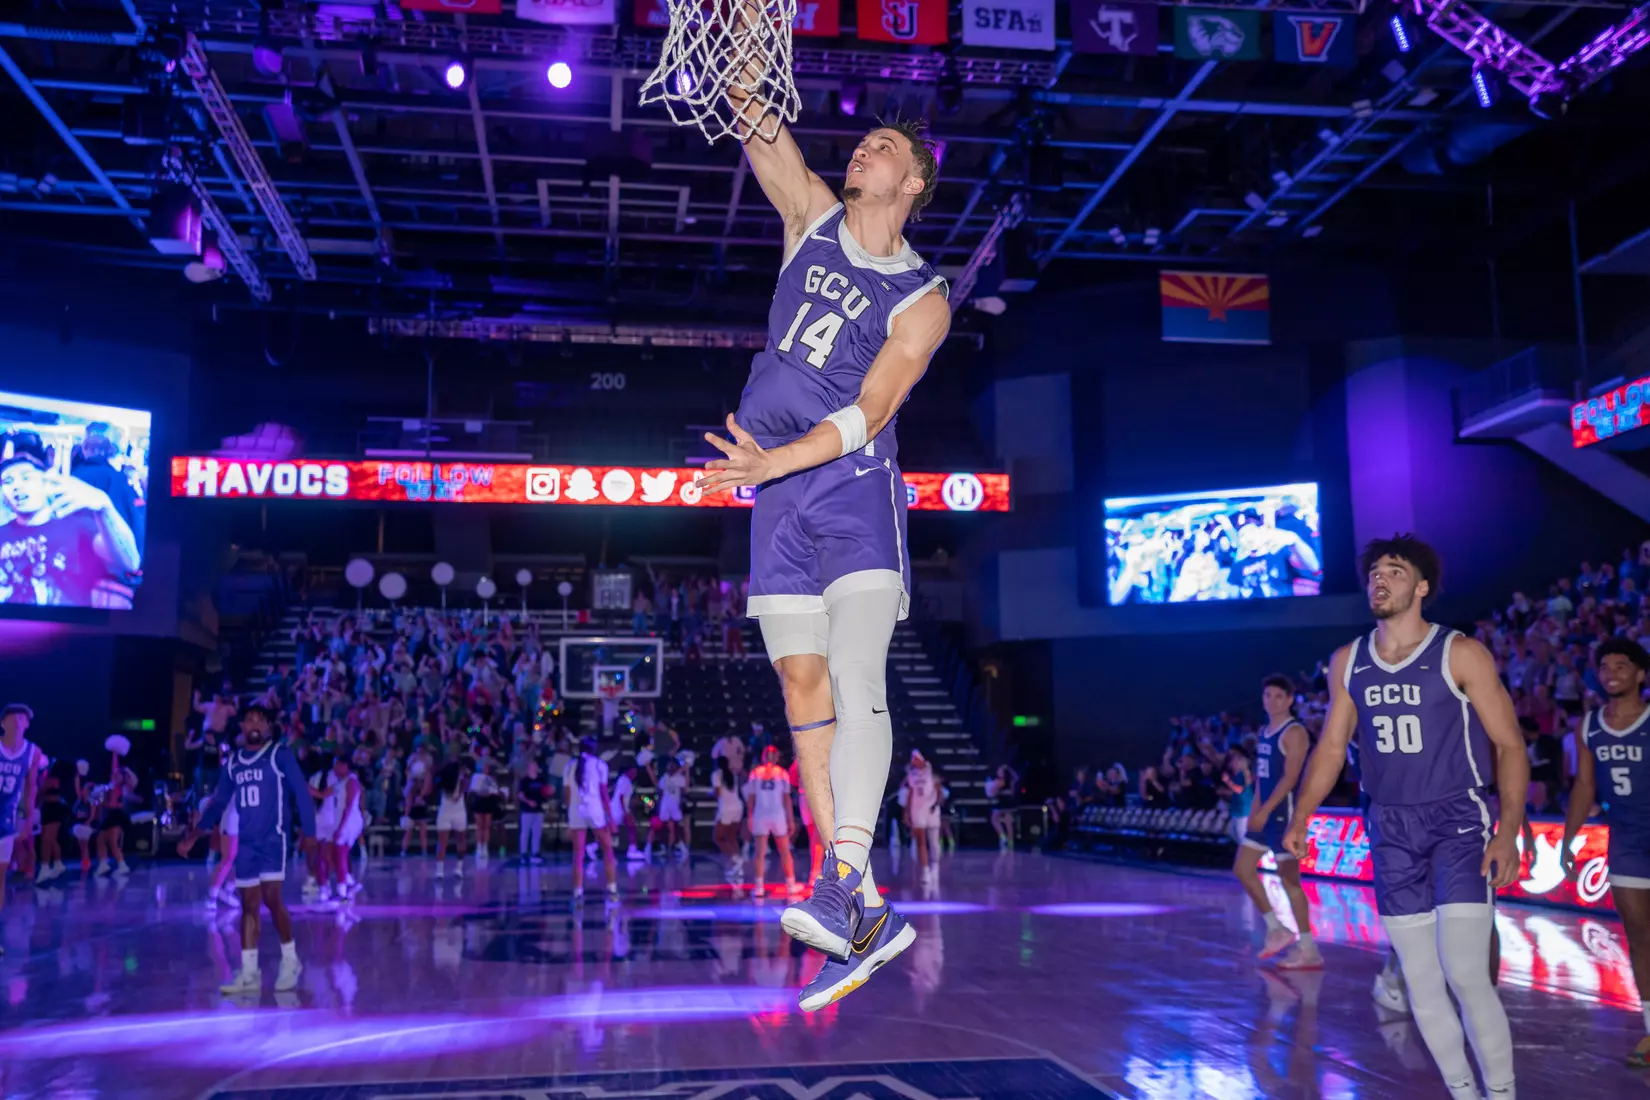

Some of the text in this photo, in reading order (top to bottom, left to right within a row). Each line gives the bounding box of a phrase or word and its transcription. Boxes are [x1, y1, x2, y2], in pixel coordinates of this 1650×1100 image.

[974, 6, 1026, 32] SFA
[804, 264, 872, 321] GCU
[777, 300, 846, 371] 14
[590, 372, 626, 390] 200
[184, 457, 349, 497] HAVOCS
[378, 463, 494, 487] FOLLOW
[1364, 683, 1421, 707] GCU
[1372, 714, 1424, 754] 30
[1596, 744, 1643, 762] GCU
[236, 768, 263, 785] GCU
[1610, 766, 1632, 796] 5
[240, 785, 260, 807] 10
